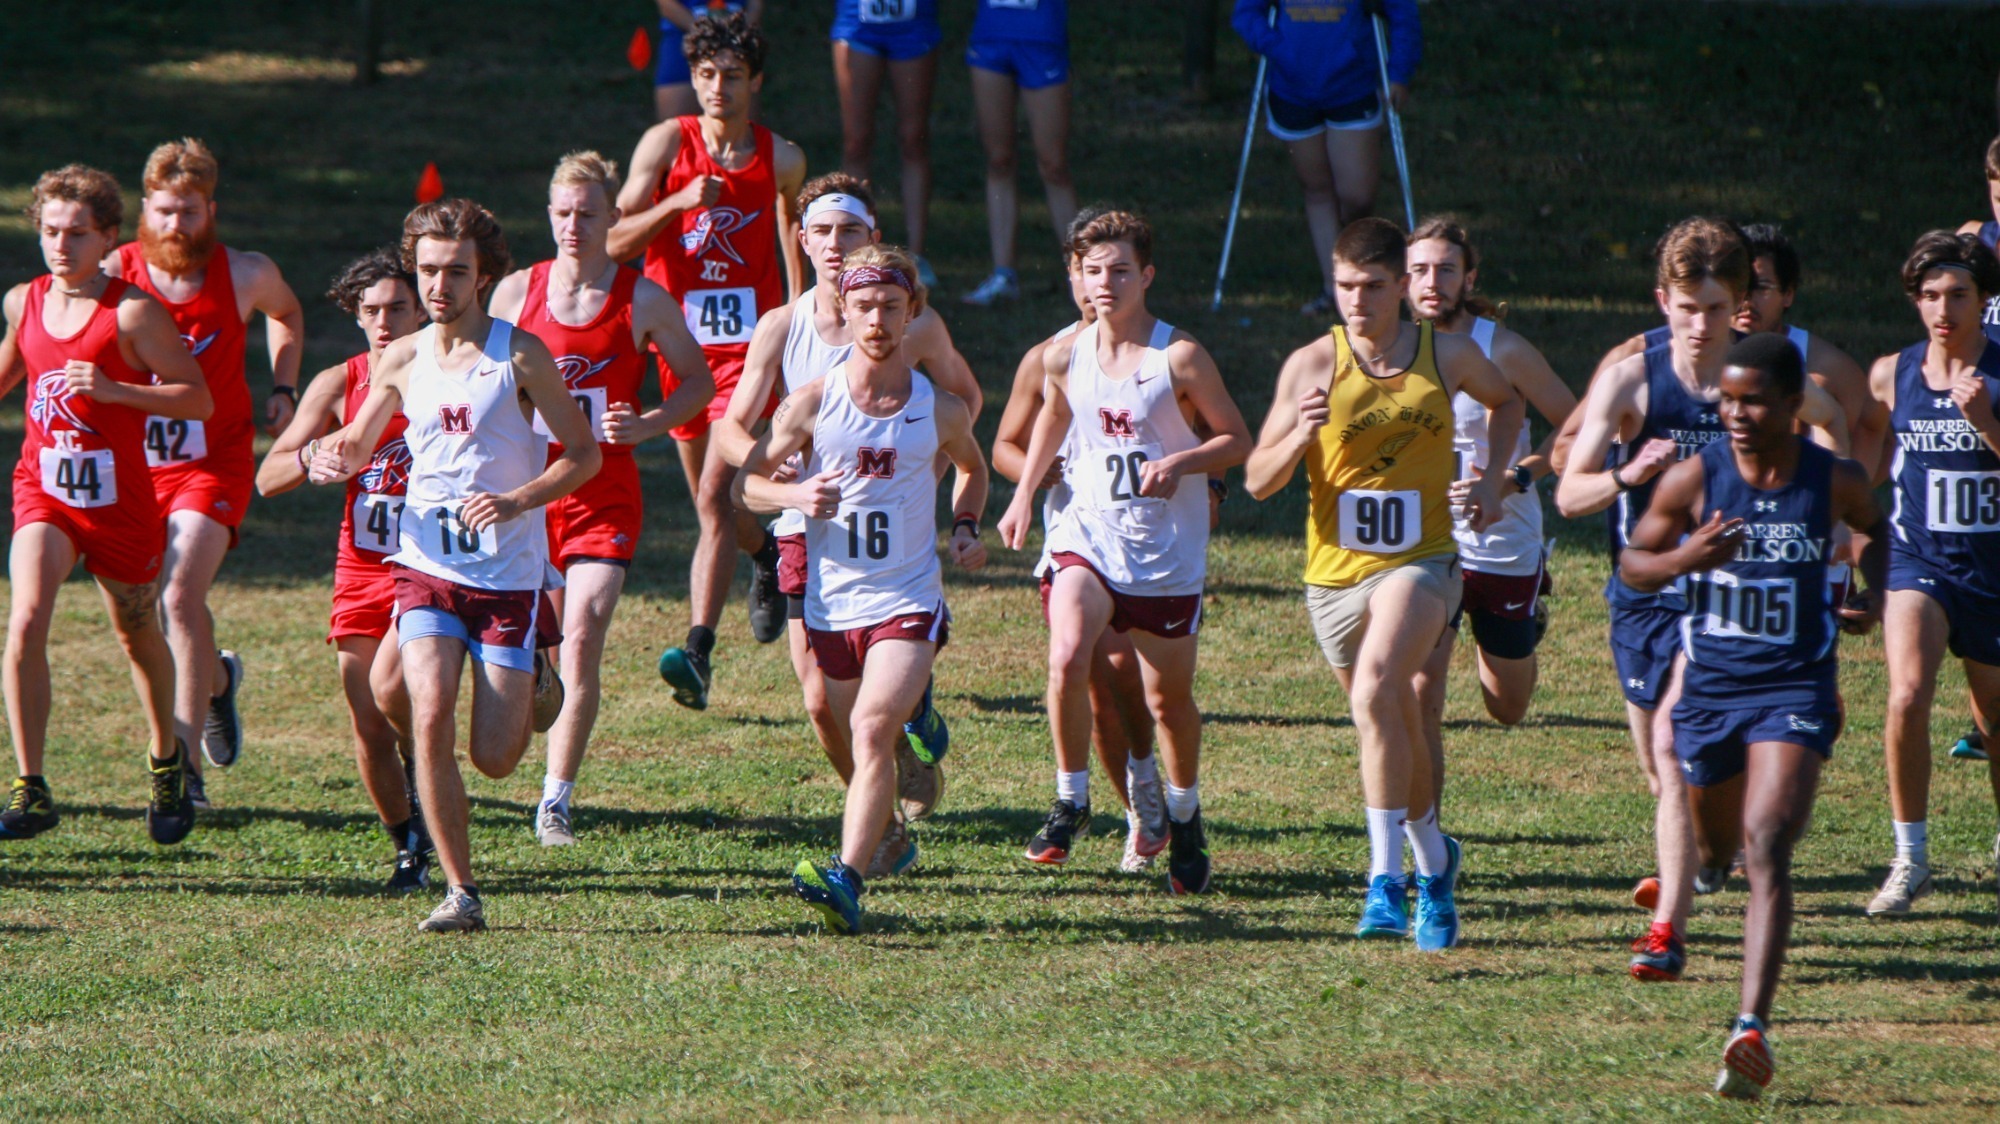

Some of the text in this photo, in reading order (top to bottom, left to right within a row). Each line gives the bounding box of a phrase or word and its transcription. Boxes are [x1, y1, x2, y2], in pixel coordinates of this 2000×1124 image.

[700, 259, 729, 282] XC
[700, 293, 743, 336] 43
[439, 404, 472, 435] M
[1100, 408, 1135, 437] M
[1339, 406, 1446, 443] OXON HILL
[1669, 429, 1731, 443] WARR
[51, 430, 82, 452] XC
[147, 420, 192, 461] 42
[56, 457, 102, 500] 44
[857, 446, 897, 479] M
[1106, 451, 1148, 501] 20
[1934, 476, 2000, 526] 103
[437, 504, 480, 555] 18
[843, 511, 889, 560] 16
[1356, 497, 1405, 546] 90
[1739, 523, 1808, 539] ARREN
[1734, 538, 1825, 562] ILSON
[1717, 585, 1791, 637] 105
